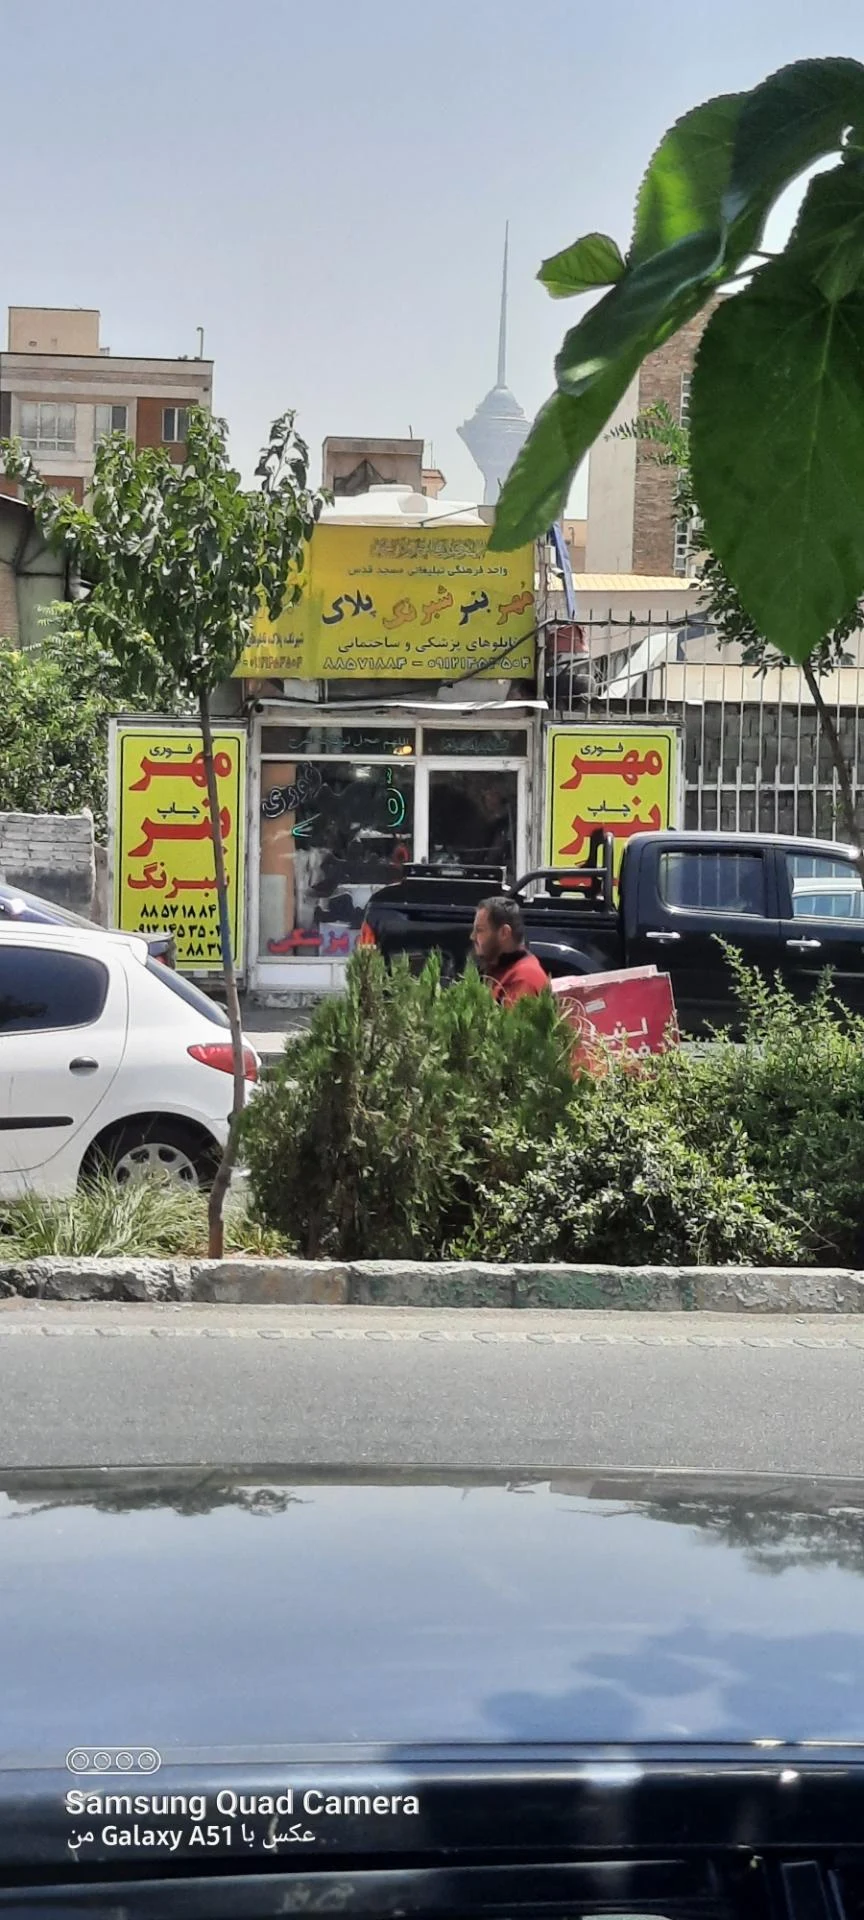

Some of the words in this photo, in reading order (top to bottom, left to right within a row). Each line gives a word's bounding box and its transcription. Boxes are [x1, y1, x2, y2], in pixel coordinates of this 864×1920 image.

[321, 589, 376, 625] پلاک
[459, 590, 489, 626] بنر
[337, 636, 400, 653] ساختمانی
[405, 640, 411, 652] و
[415, 635, 461, 653] پزشکی
[322, 656, 408, 670] ۸۸۵۷۱۸۸۴
[148, 743, 193, 759] فوری
[580, 741, 624, 757] فوری
[128, 751, 232, 791] مهر
[559, 749, 663, 790] مهر
[157, 801, 200, 819] چاپ
[587, 799, 631, 817] چاپ
[127, 797, 231, 857] بنر
[558, 796, 662, 855] بنر
